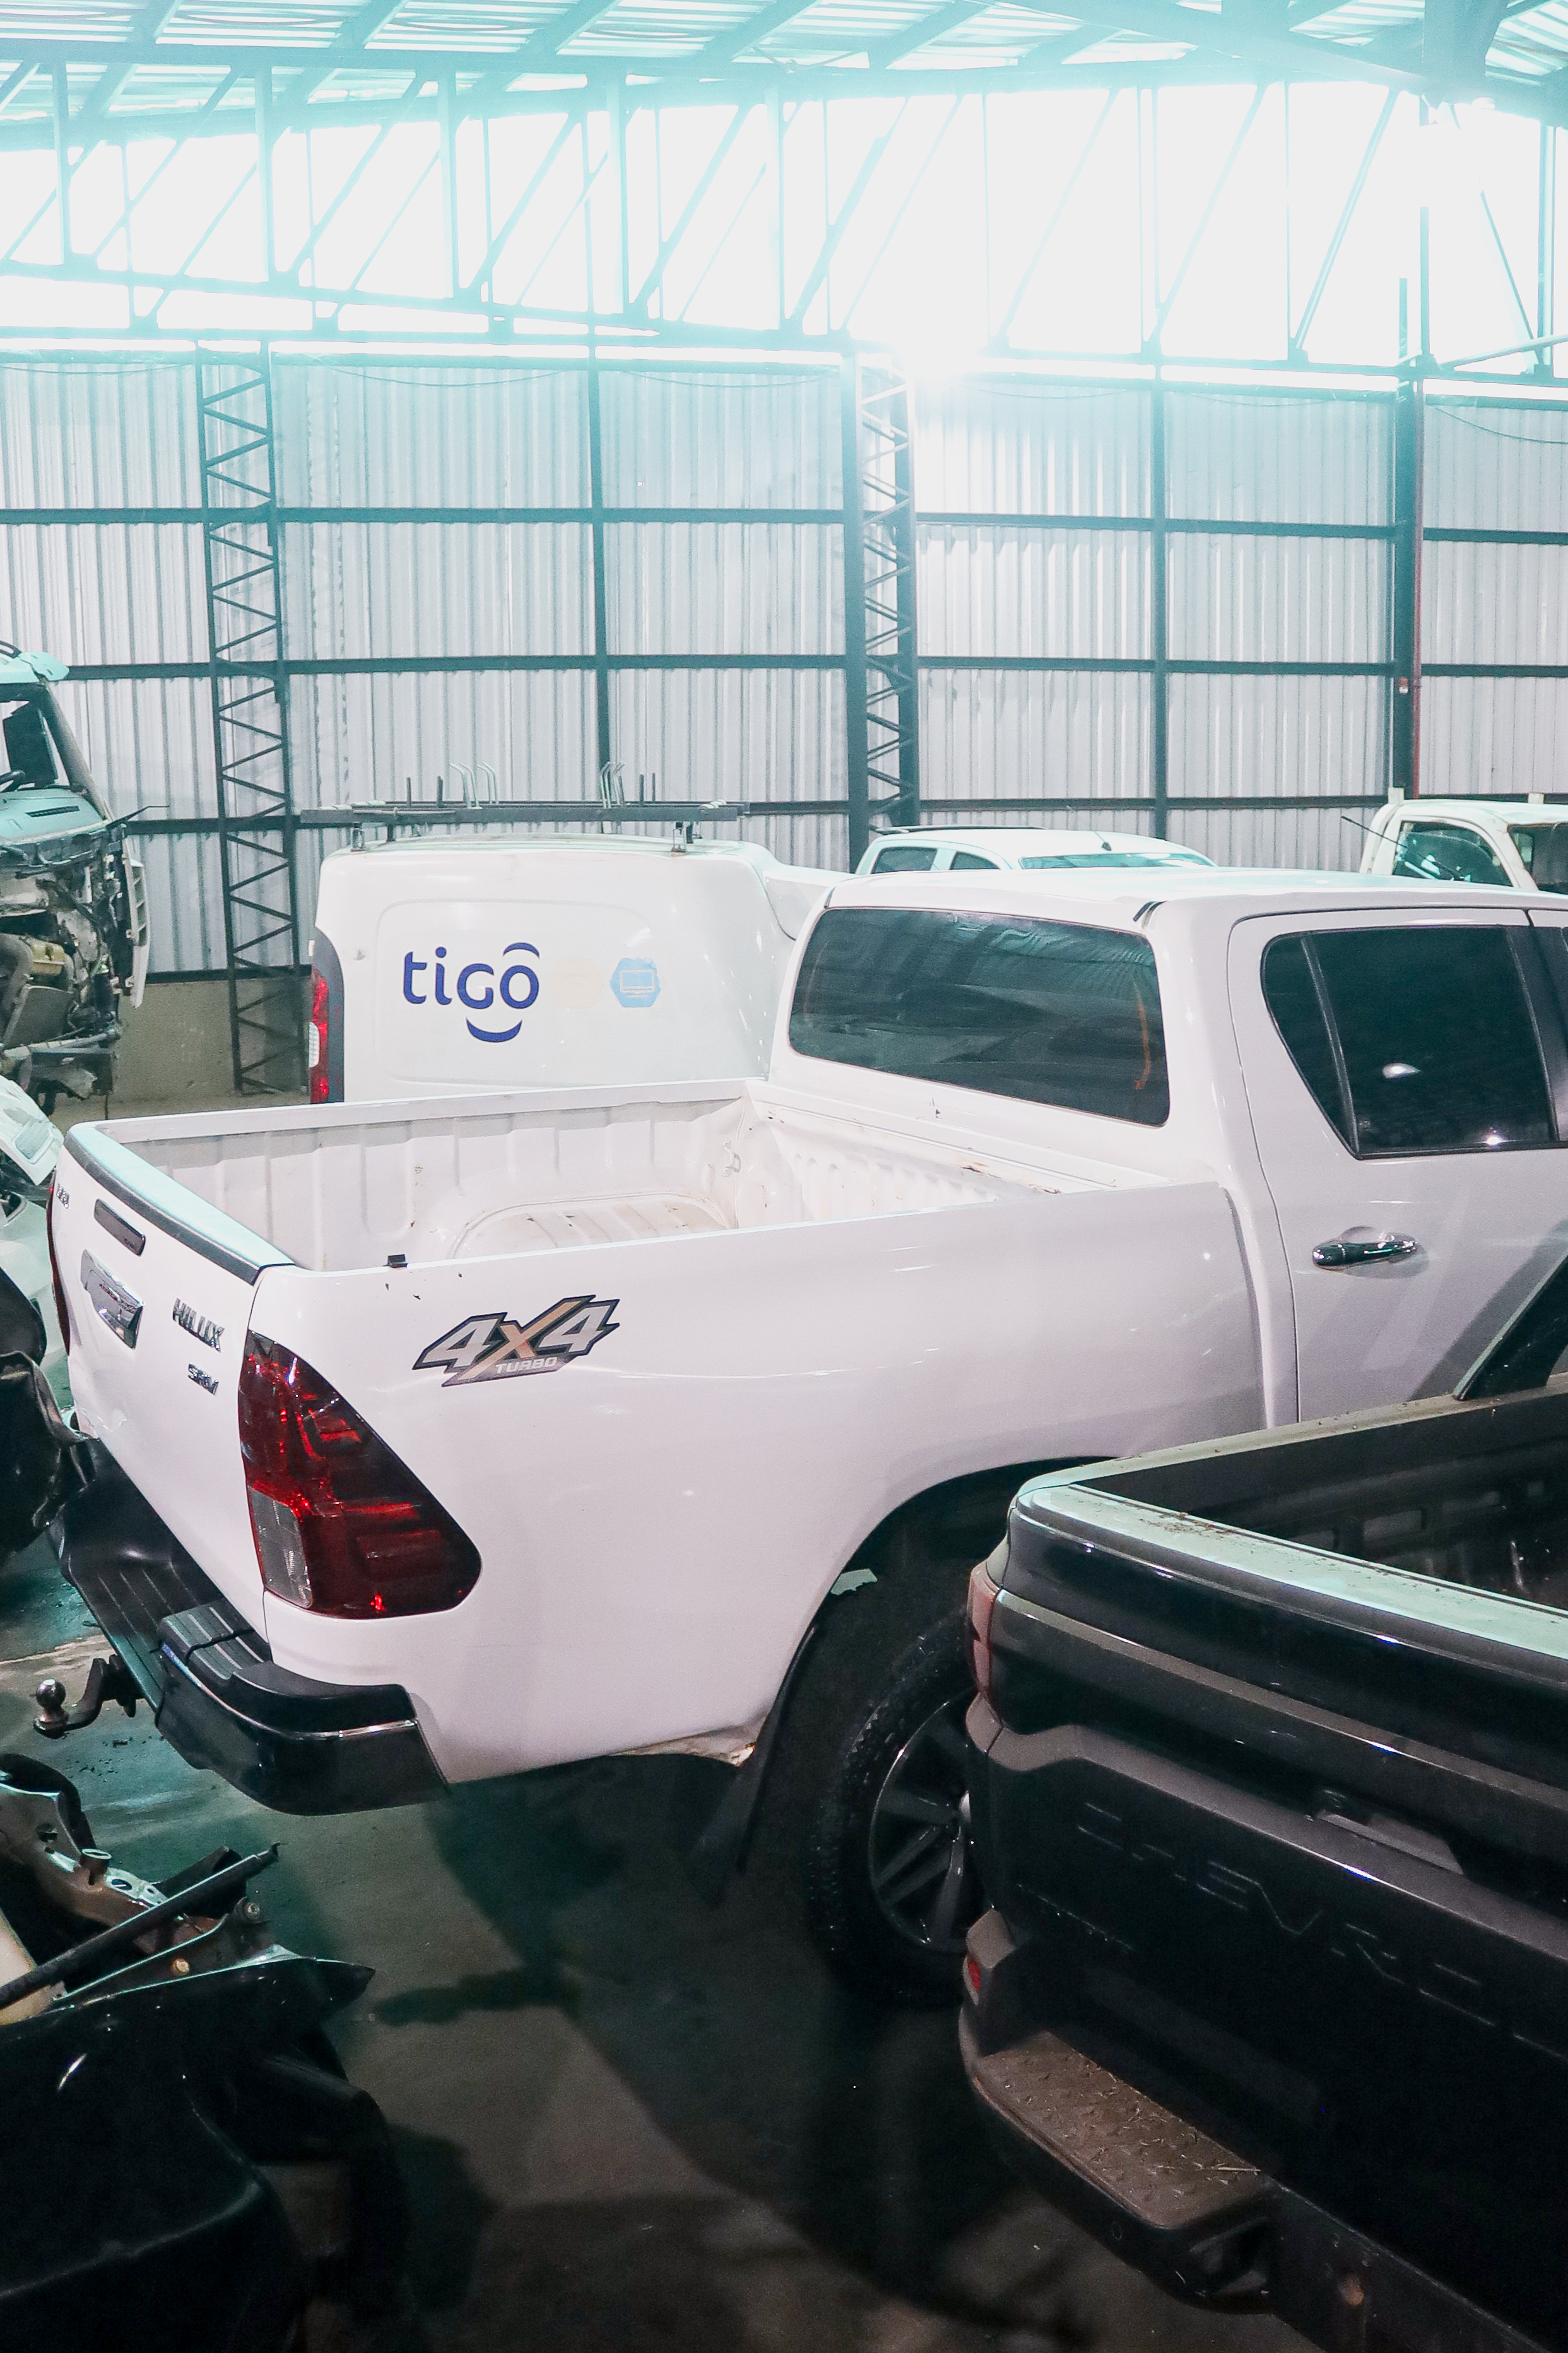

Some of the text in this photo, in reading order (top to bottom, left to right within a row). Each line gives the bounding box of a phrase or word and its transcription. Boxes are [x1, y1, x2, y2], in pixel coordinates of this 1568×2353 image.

[403, 943, 539, 1010] tigo
[172, 1298, 225, 1353] HILUX
[494, 1356, 558, 1375] TURBO
